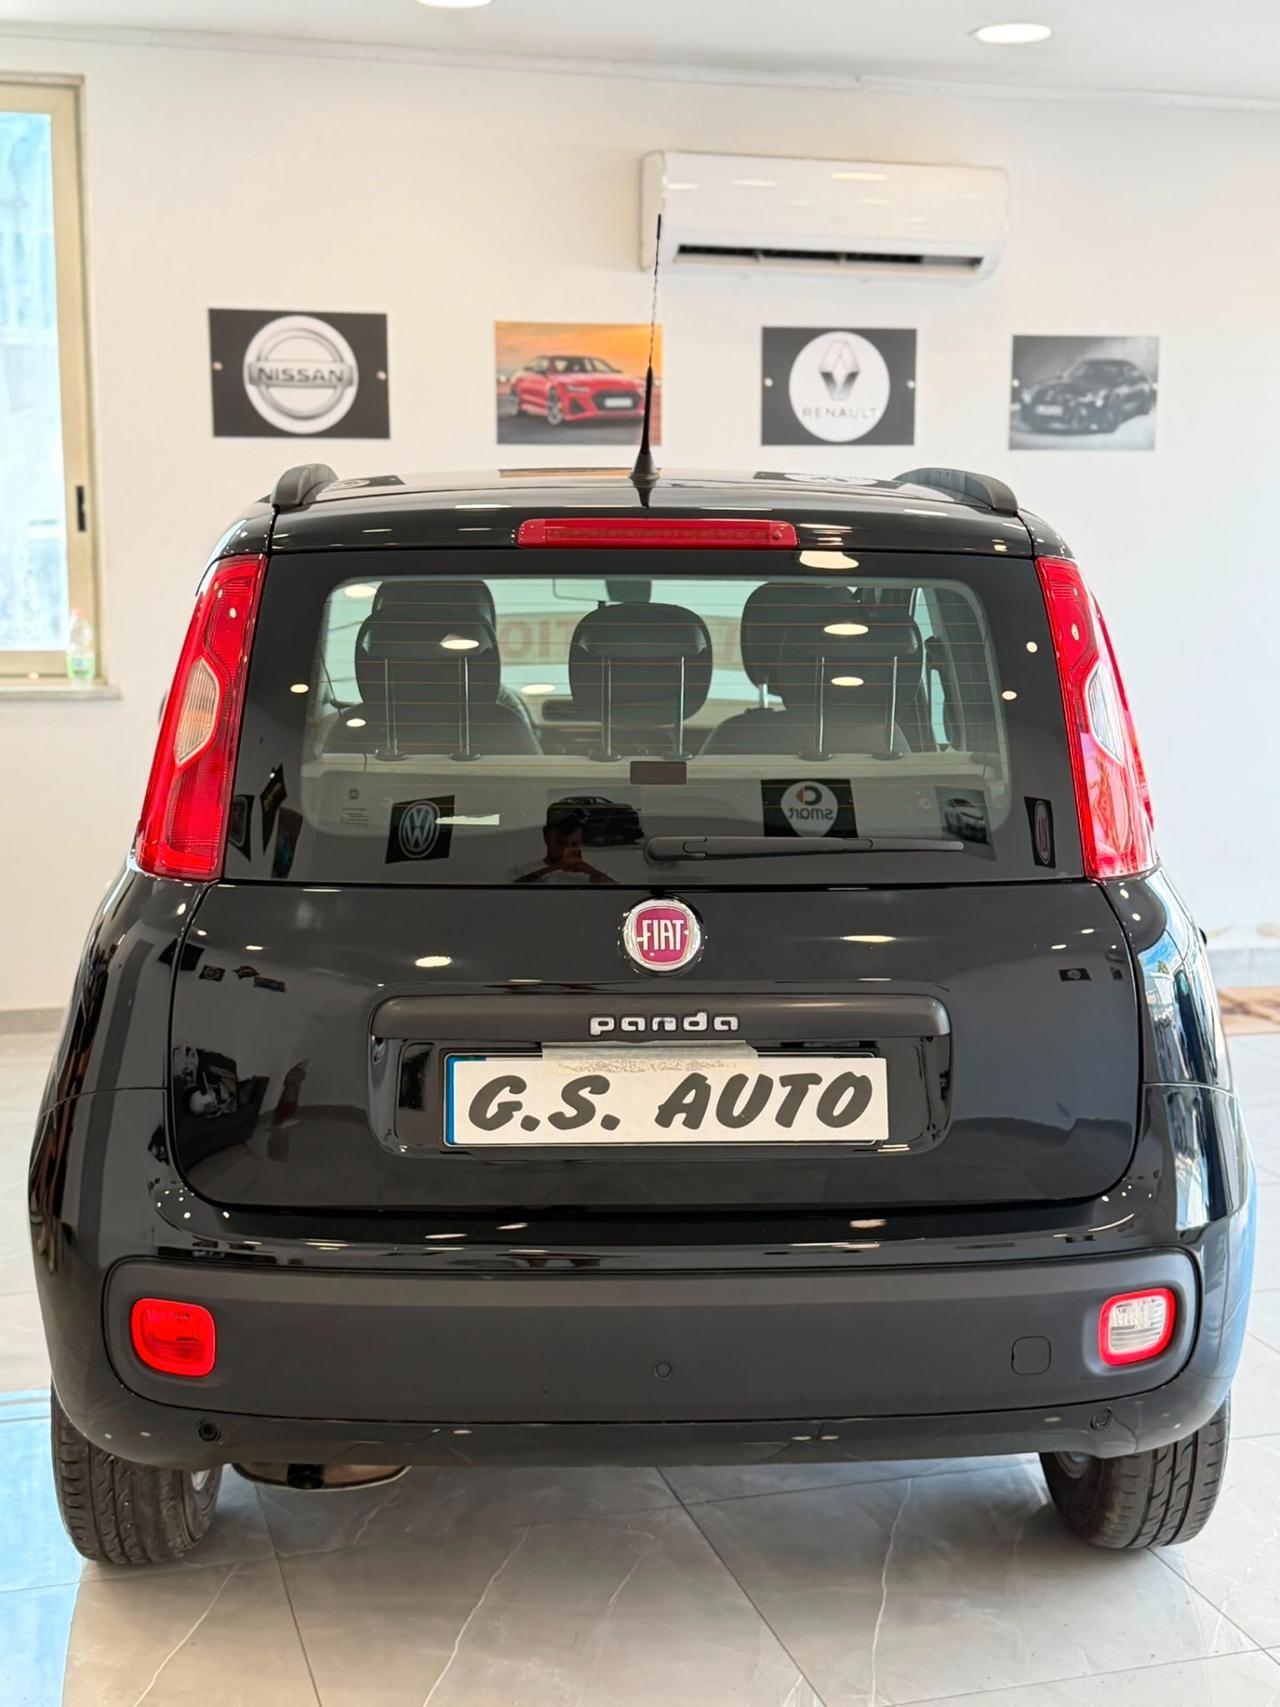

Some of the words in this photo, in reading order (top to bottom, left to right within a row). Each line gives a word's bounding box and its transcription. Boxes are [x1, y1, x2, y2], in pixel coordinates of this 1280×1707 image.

[257, 367, 344, 383] NISSAN
[802, 406, 878, 419] RENAULT
[641, 919, 685, 951] FIAT
[589, 1011, 739, 1036] panda
[467, 1074, 621, 1133] G.S.
[654, 1070, 873, 1131] AUTO
